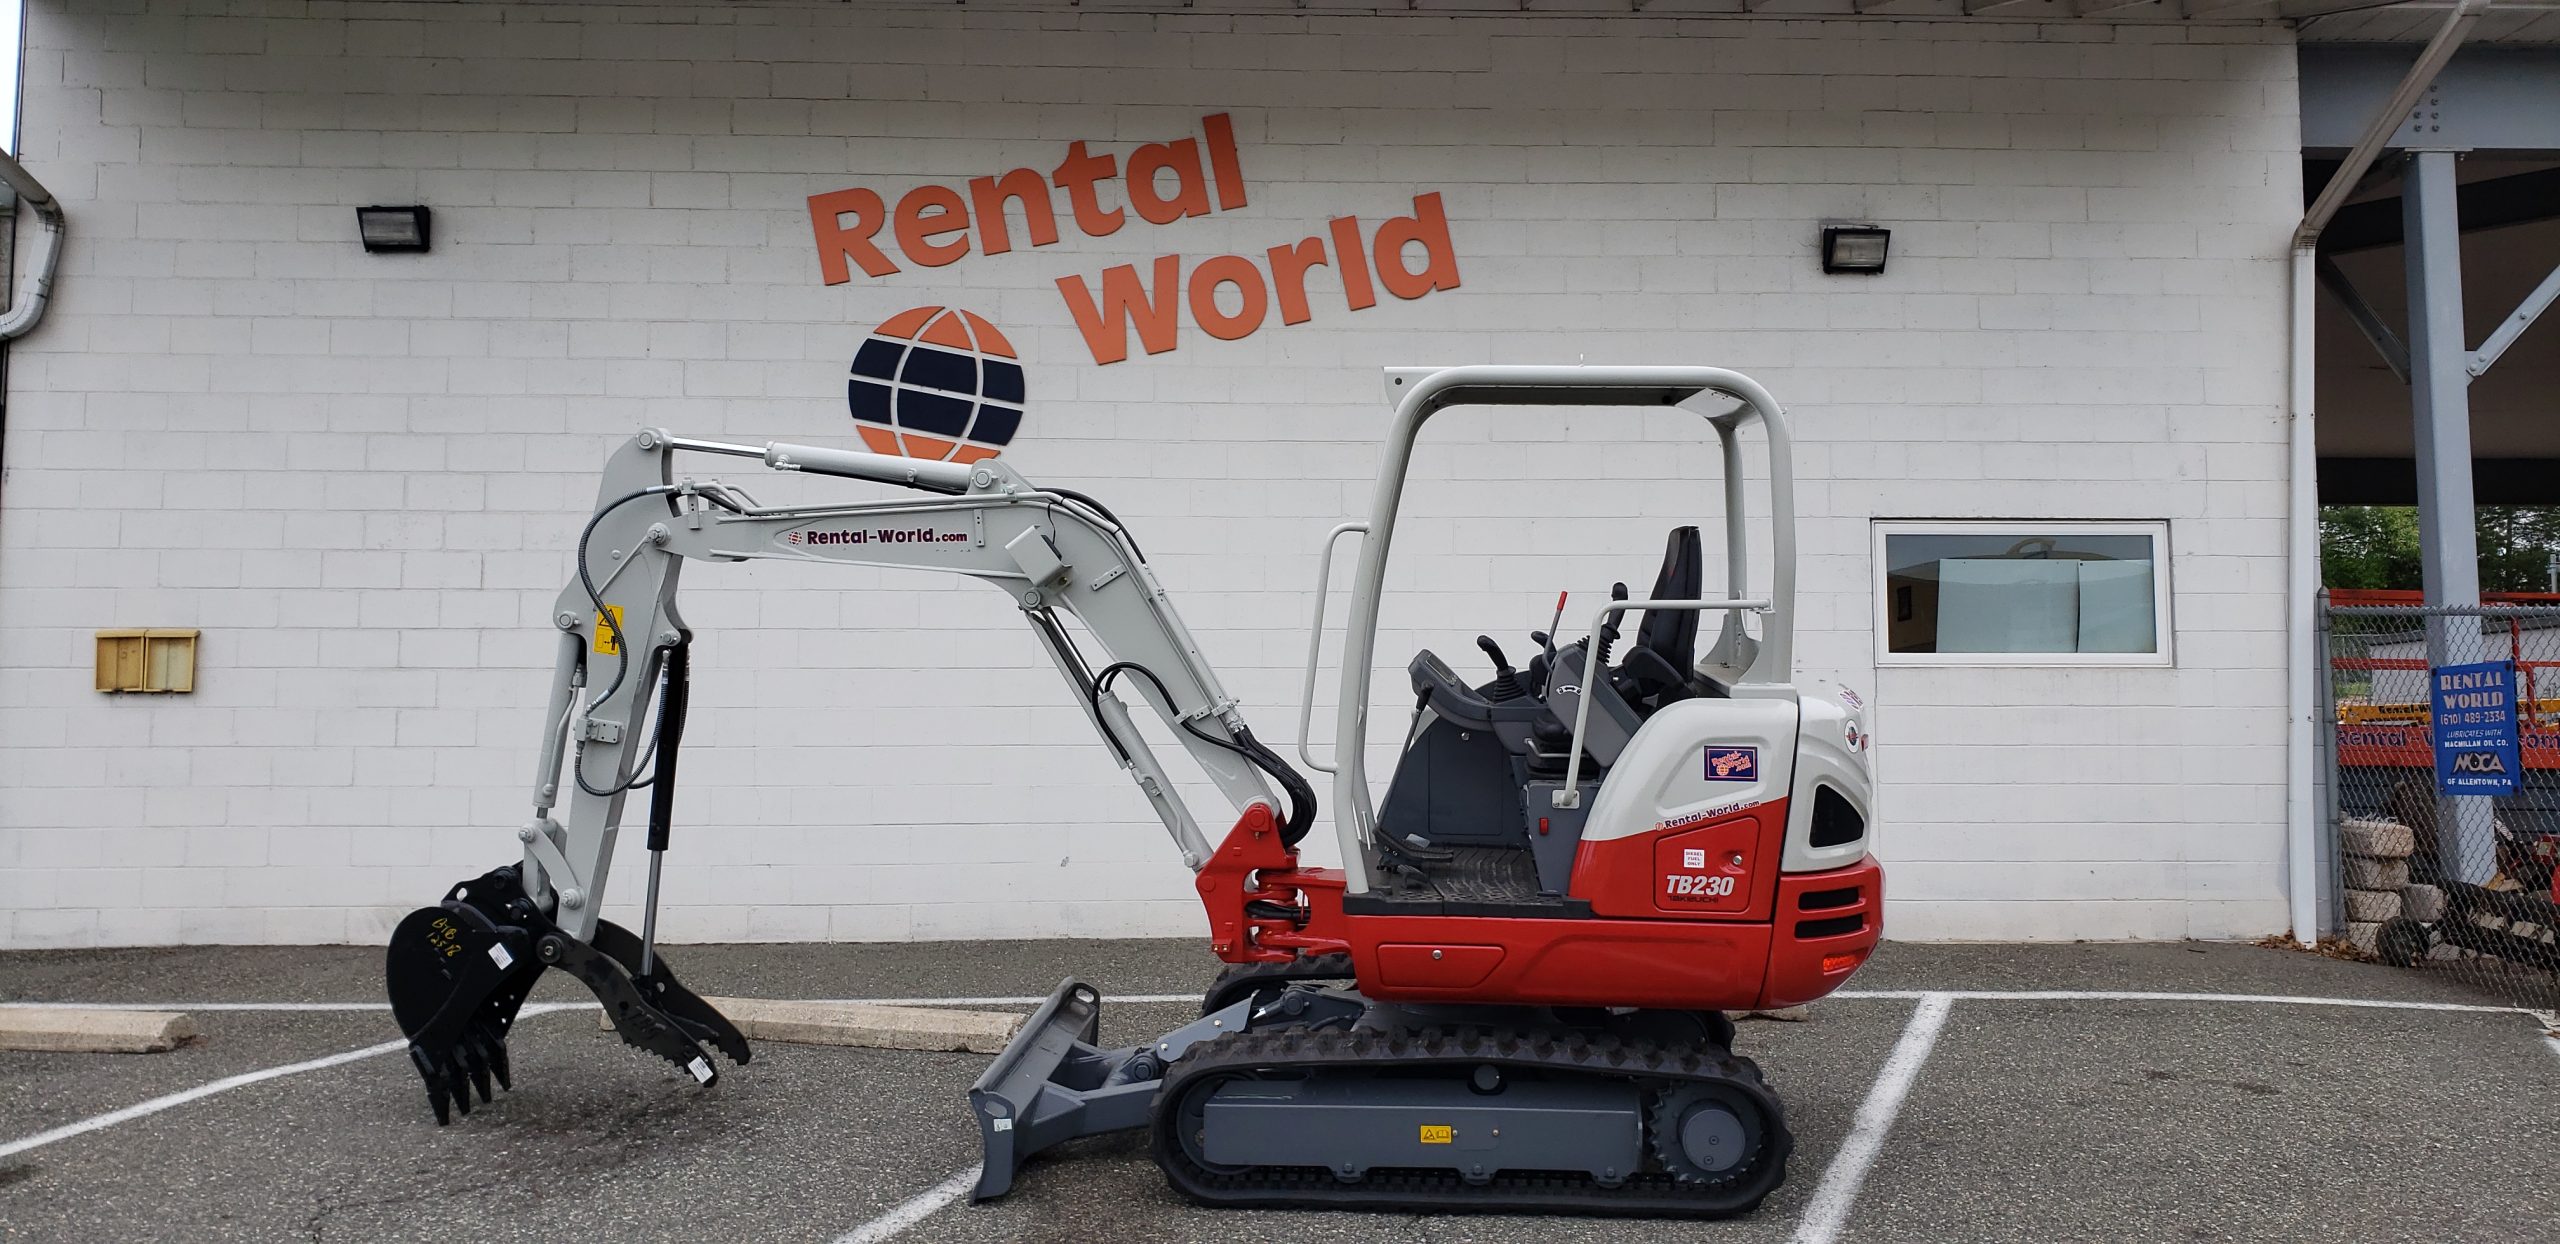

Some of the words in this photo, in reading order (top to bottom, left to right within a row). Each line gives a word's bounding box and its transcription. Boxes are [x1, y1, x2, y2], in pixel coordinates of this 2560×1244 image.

[807, 112, 1248, 286] Rental
[1055, 191, 1461, 366] World
[806, 527, 968, 545] Rental-World.com
[2440, 671, 2505, 691] RENTAL
[2443, 691, 2504, 709] WORLD
[2440, 713, 2461, 725] (610)
[2464, 710, 2506, 724] 489-2334
[2447, 729, 2484, 739] LUBRICATES
[2485, 728, 2503, 737] WITH
[2444, 740, 2481, 748] MACMILLAN
[2483, 739, 2495, 747] OIL
[2496, 739, 2509, 747] CO.
[2452, 752, 2506, 773] MOCA
[2447, 778, 2456, 786] OF
[2458, 778, 2500, 787] ALLENTOWN,
[2502, 778, 2512, 786] PA
[1664, 800, 1760, 829] Rental-World.com
[1666, 874, 1735, 897] TB230
